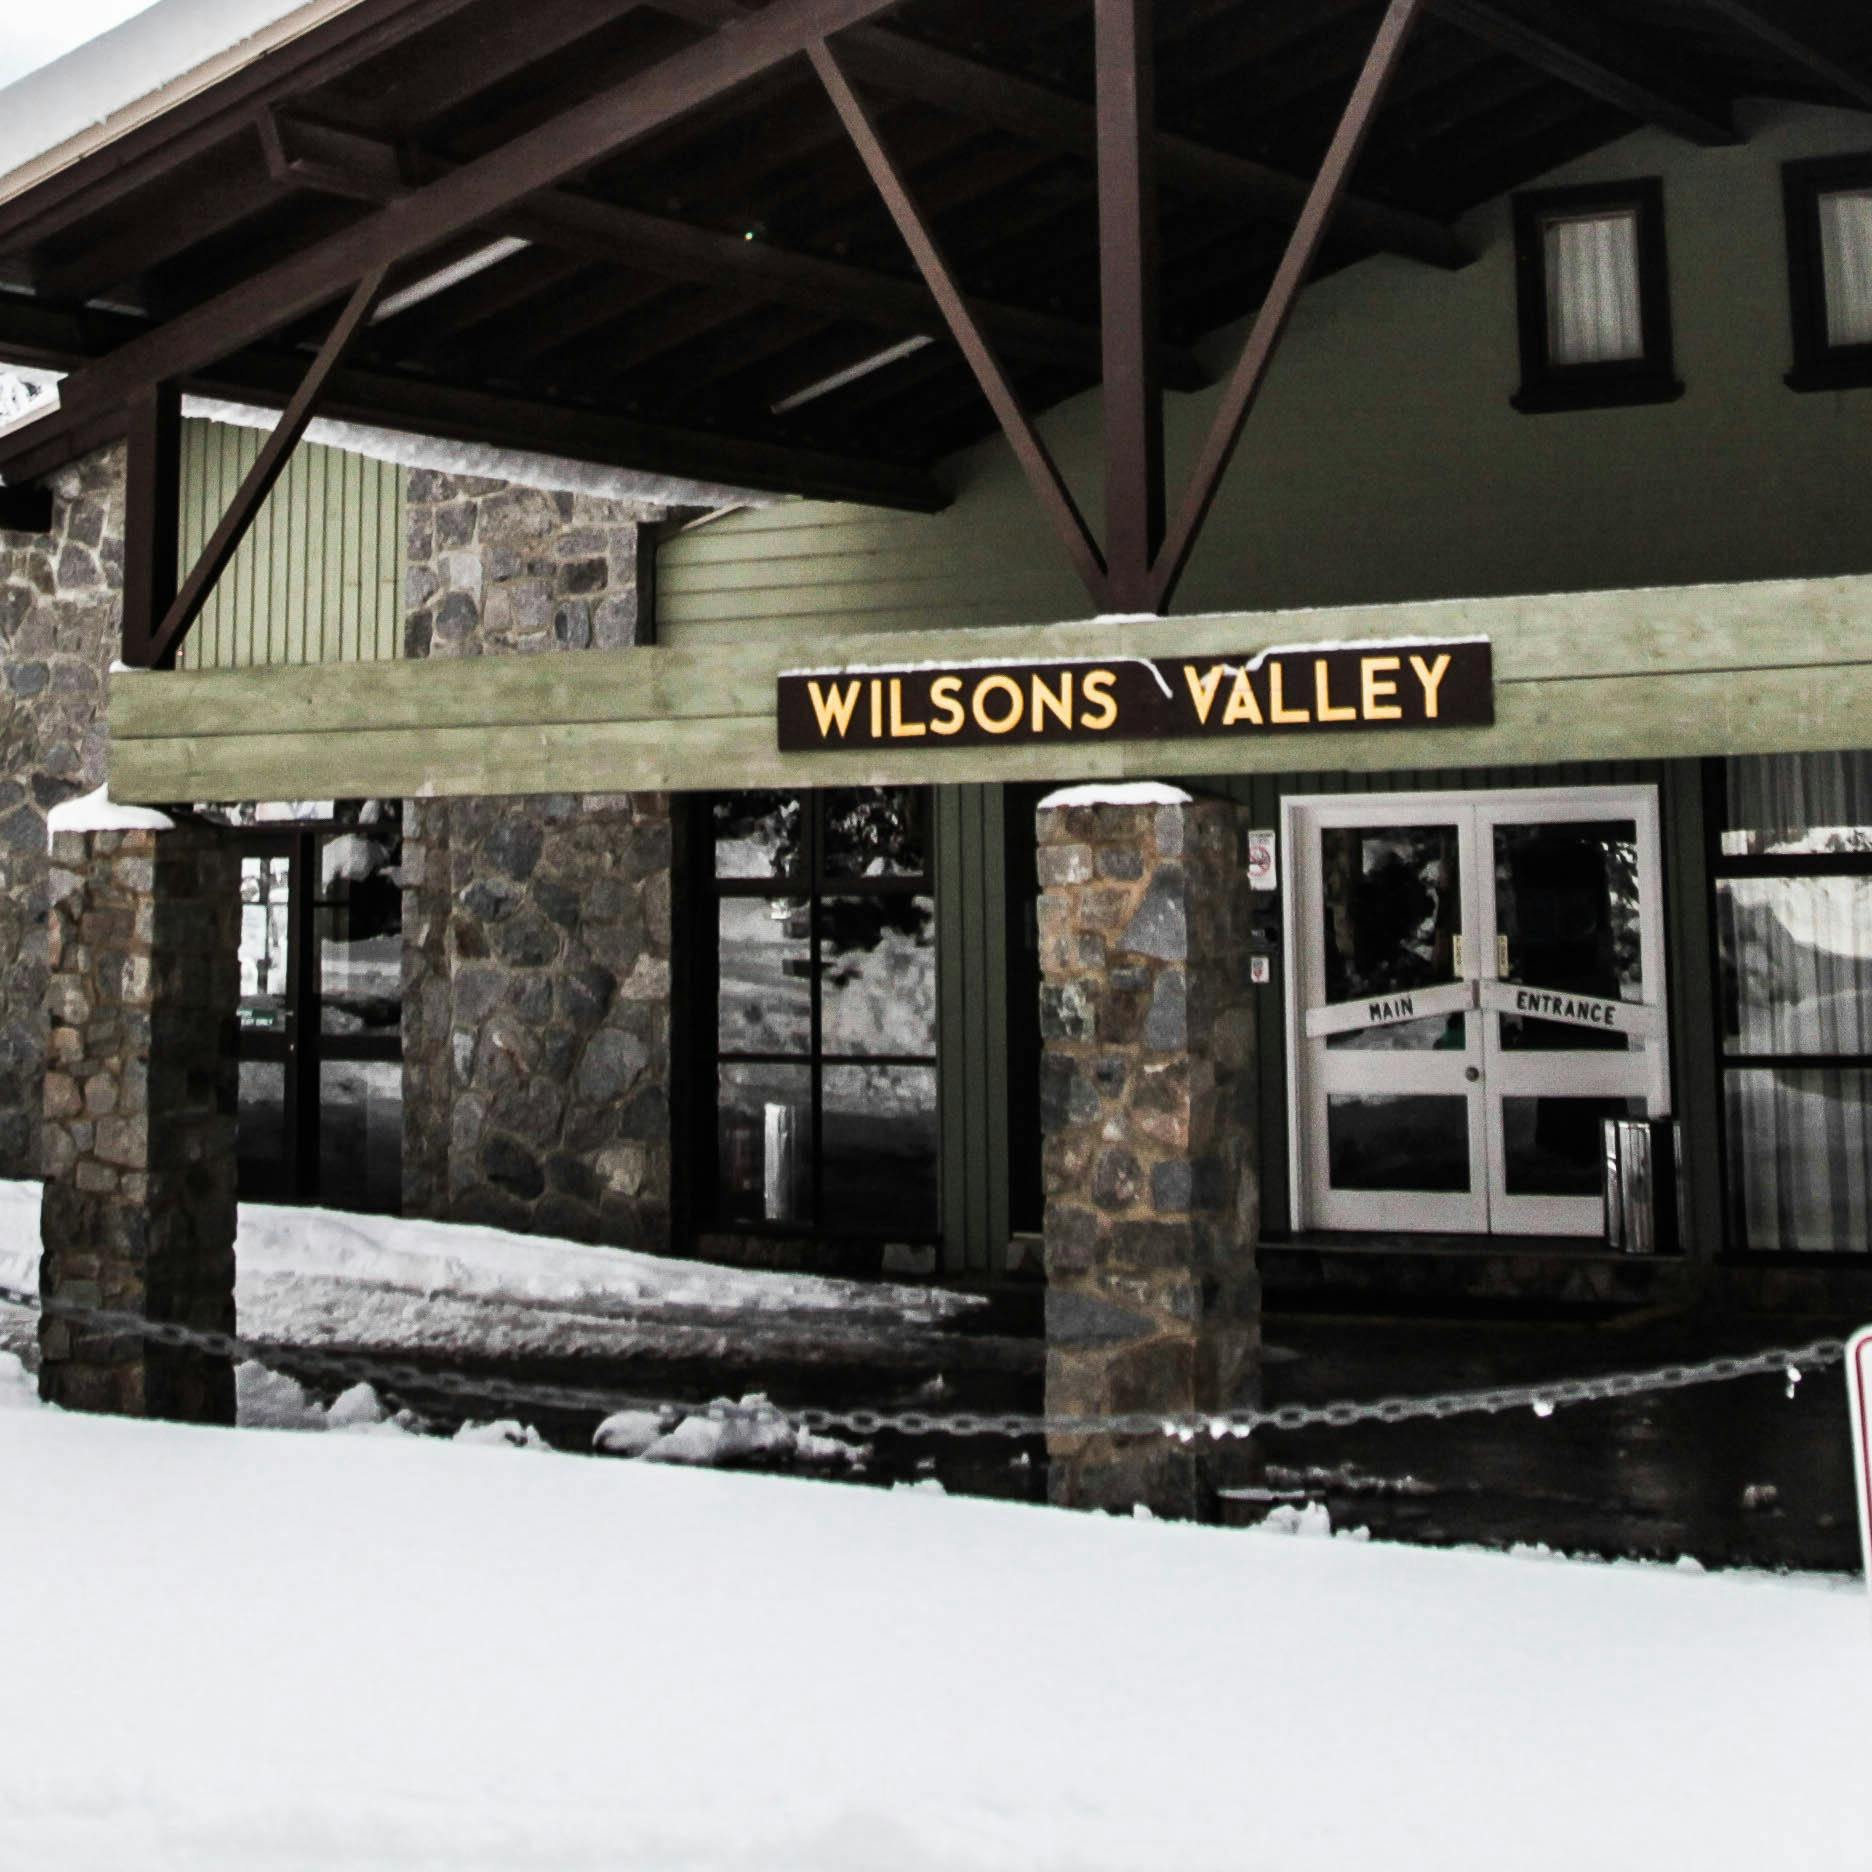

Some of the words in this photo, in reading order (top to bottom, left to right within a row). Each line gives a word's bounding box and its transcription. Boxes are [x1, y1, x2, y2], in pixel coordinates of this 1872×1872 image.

[807, 670, 1119, 739] WILSONS
[1184, 654, 1452, 727] VALLEY
[1368, 997, 1415, 1022] MAIN
[1516, 990, 1617, 1026] ENTRANCE
